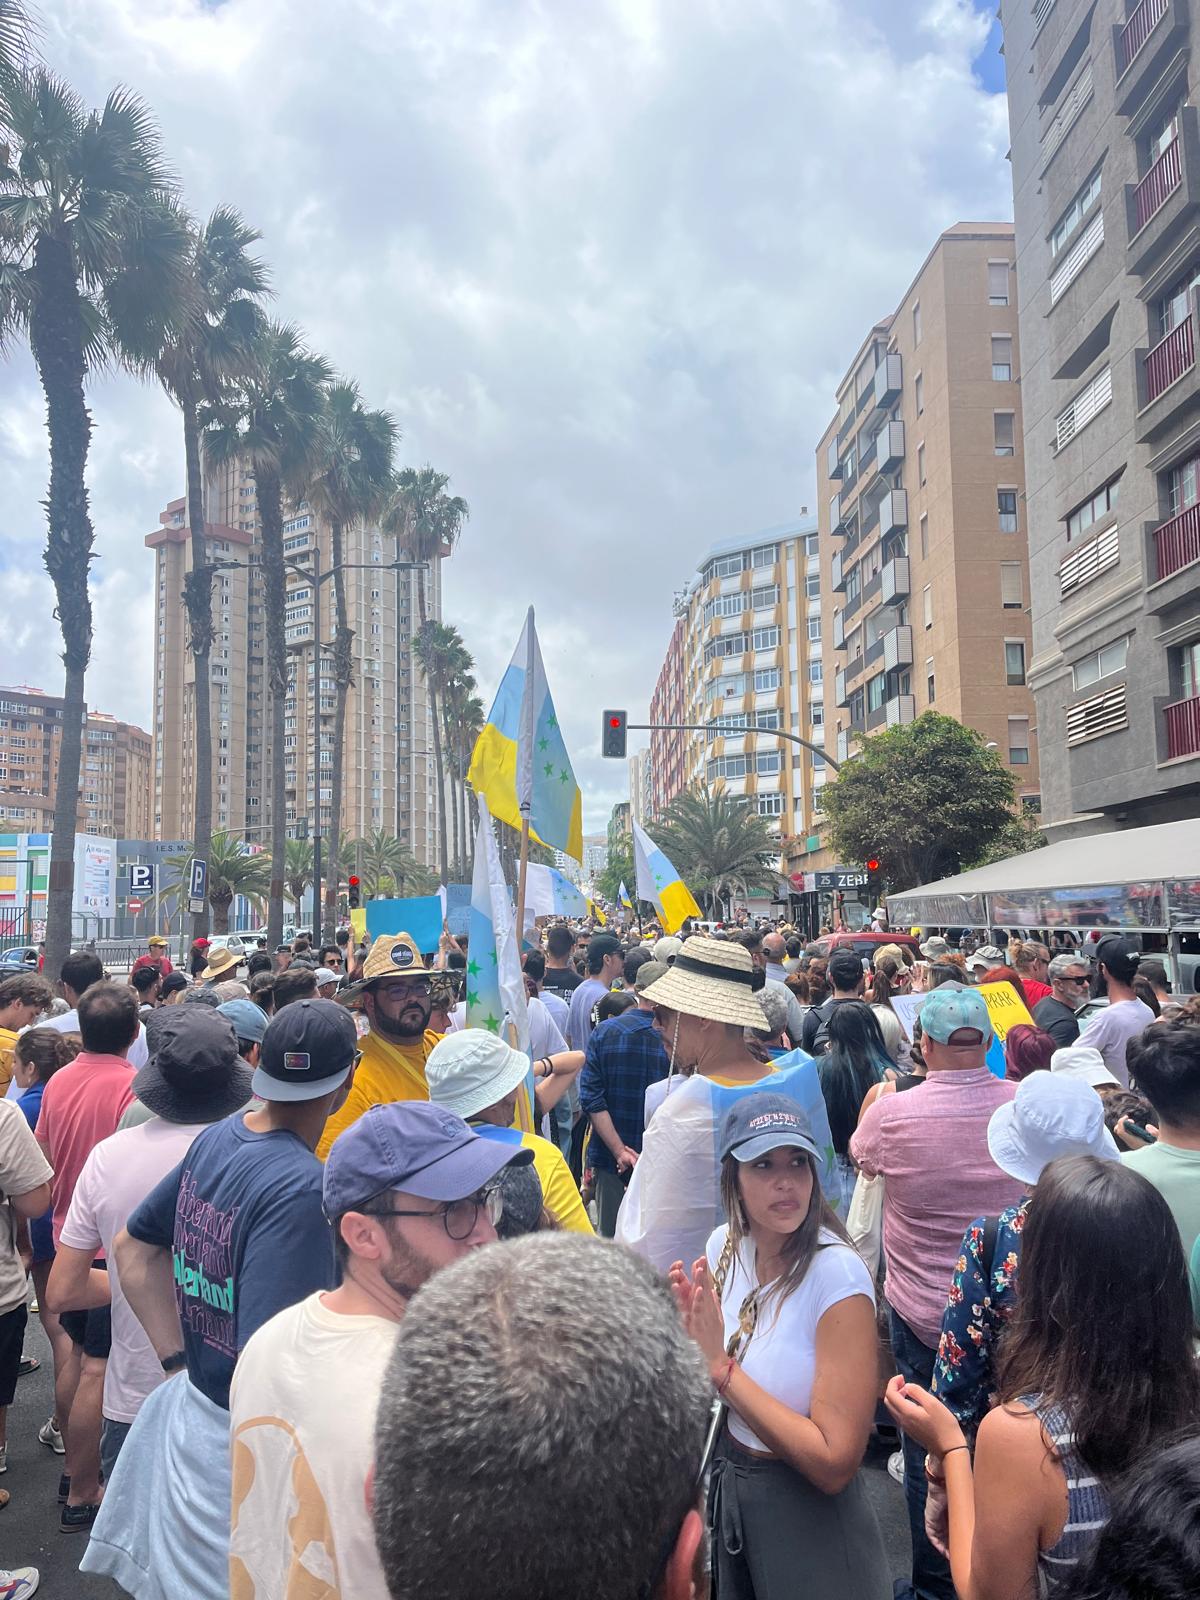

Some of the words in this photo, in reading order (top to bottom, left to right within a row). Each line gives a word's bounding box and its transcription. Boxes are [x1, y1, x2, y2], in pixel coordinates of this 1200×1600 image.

[132, 866, 150, 886] P
[194, 866, 203, 892] P
[838, 874, 869, 887] ZEB
[984, 991, 1017, 1009] PRAR
